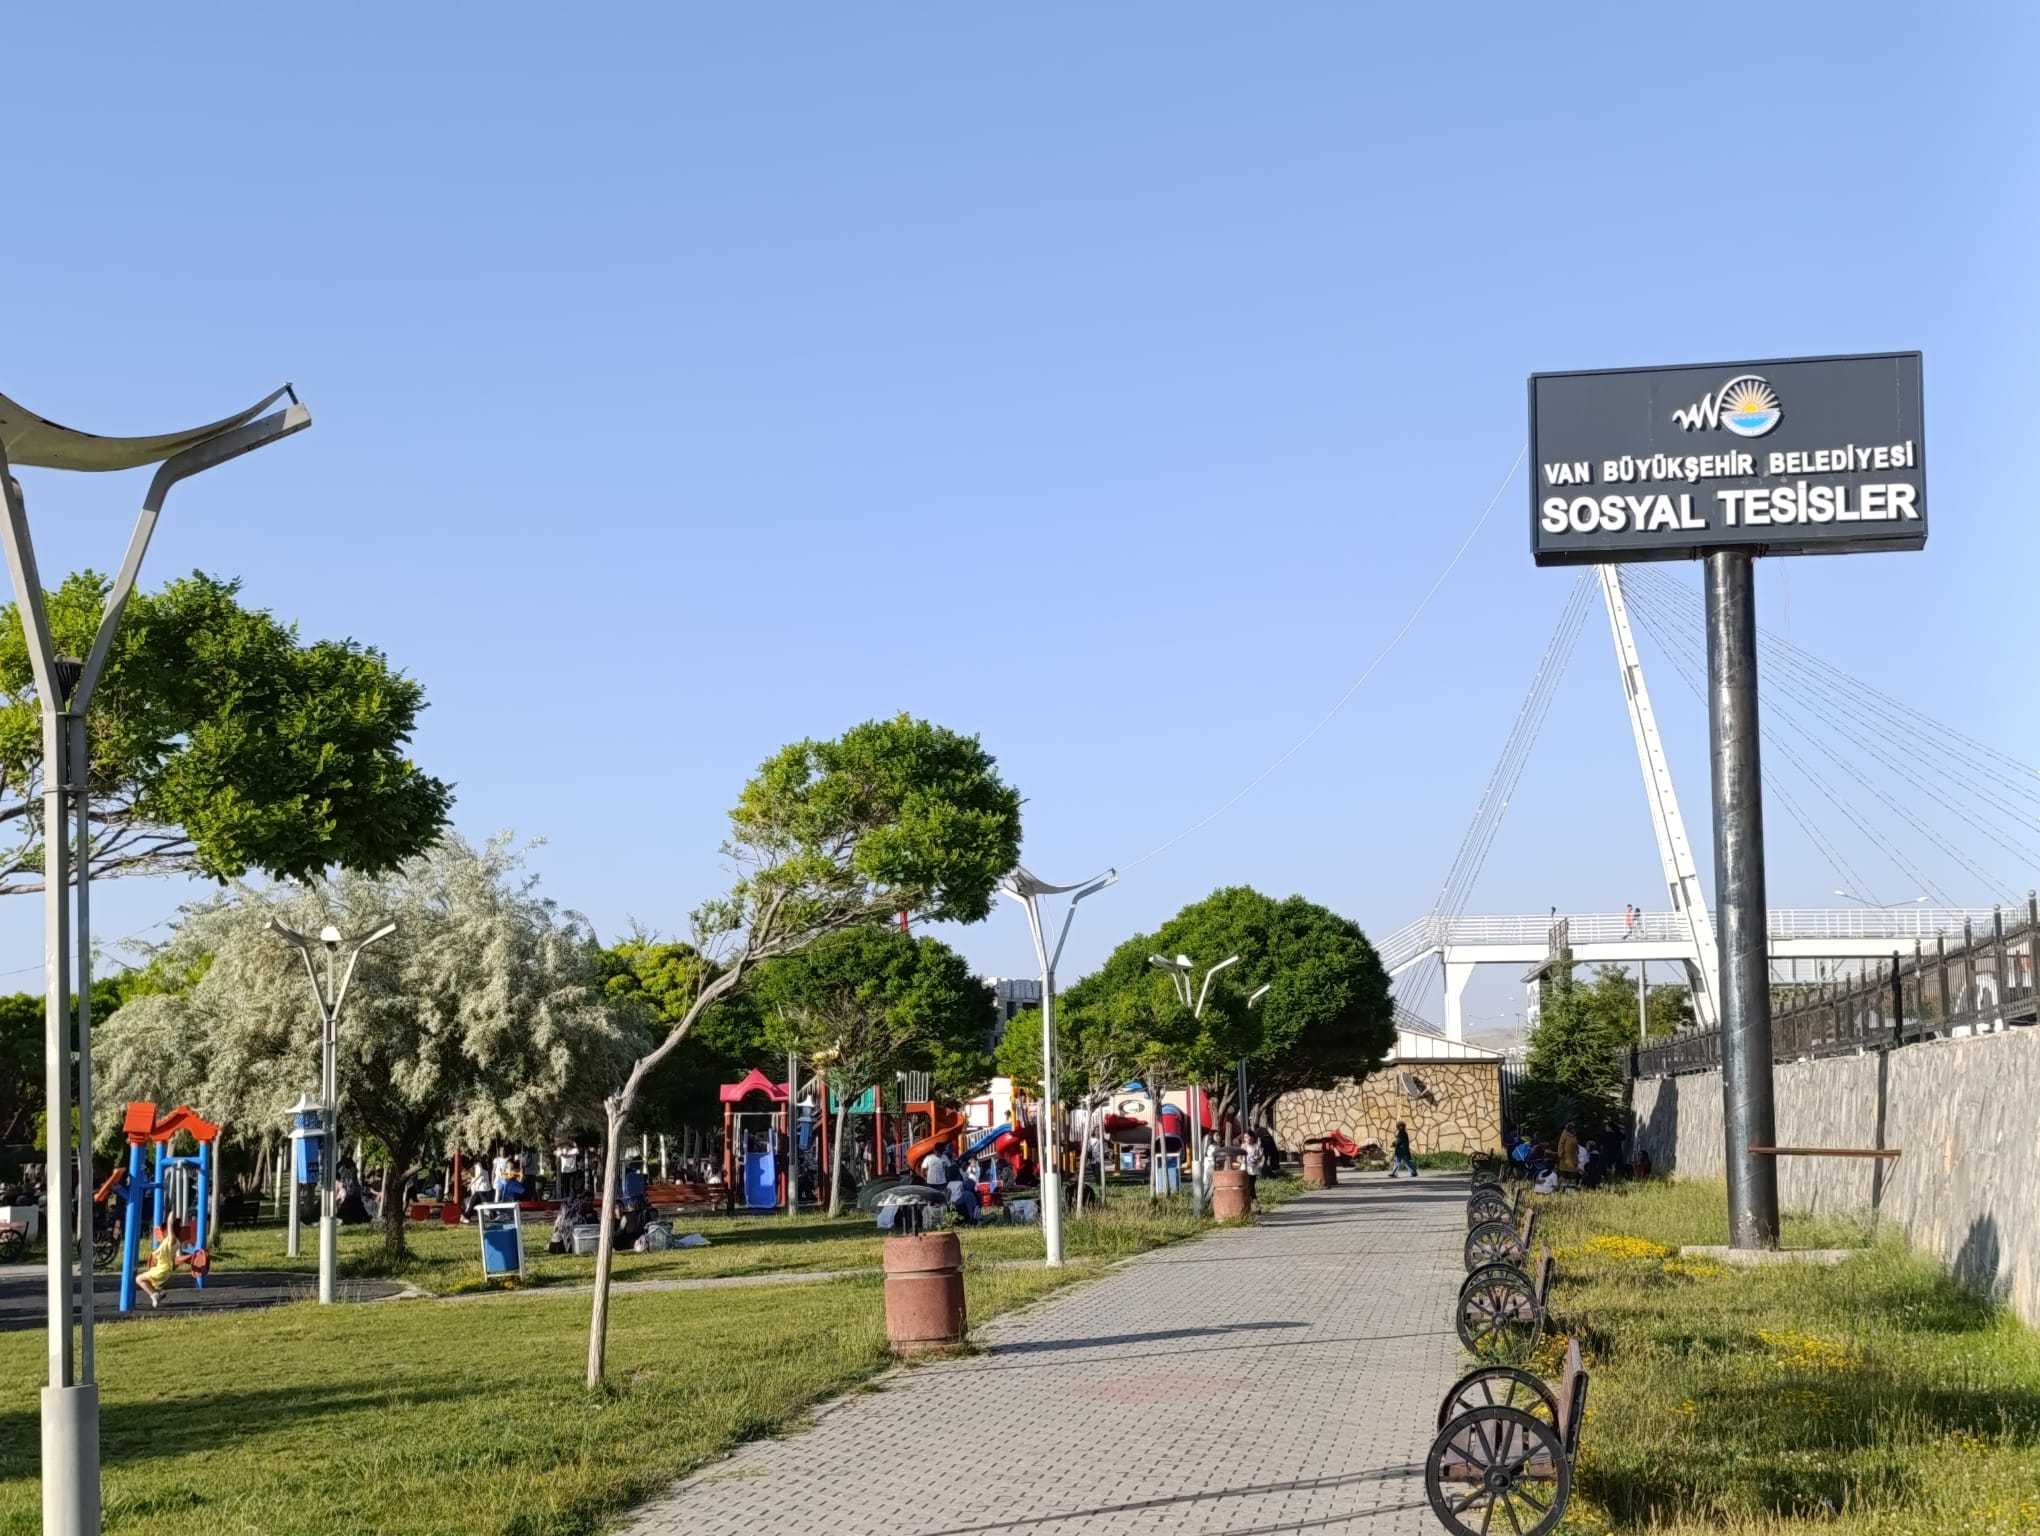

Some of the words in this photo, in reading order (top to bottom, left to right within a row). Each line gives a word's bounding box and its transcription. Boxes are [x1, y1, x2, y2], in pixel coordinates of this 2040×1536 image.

[1544, 462, 1590, 484] VAN
[1602, 449, 1754, 483] BÜYÜKŞEHİR
[1769, 440, 1914, 474] BELEDİYESİ
[1541, 493, 1705, 533] SOSYAL
[1716, 480, 1919, 526] TESİSLER
